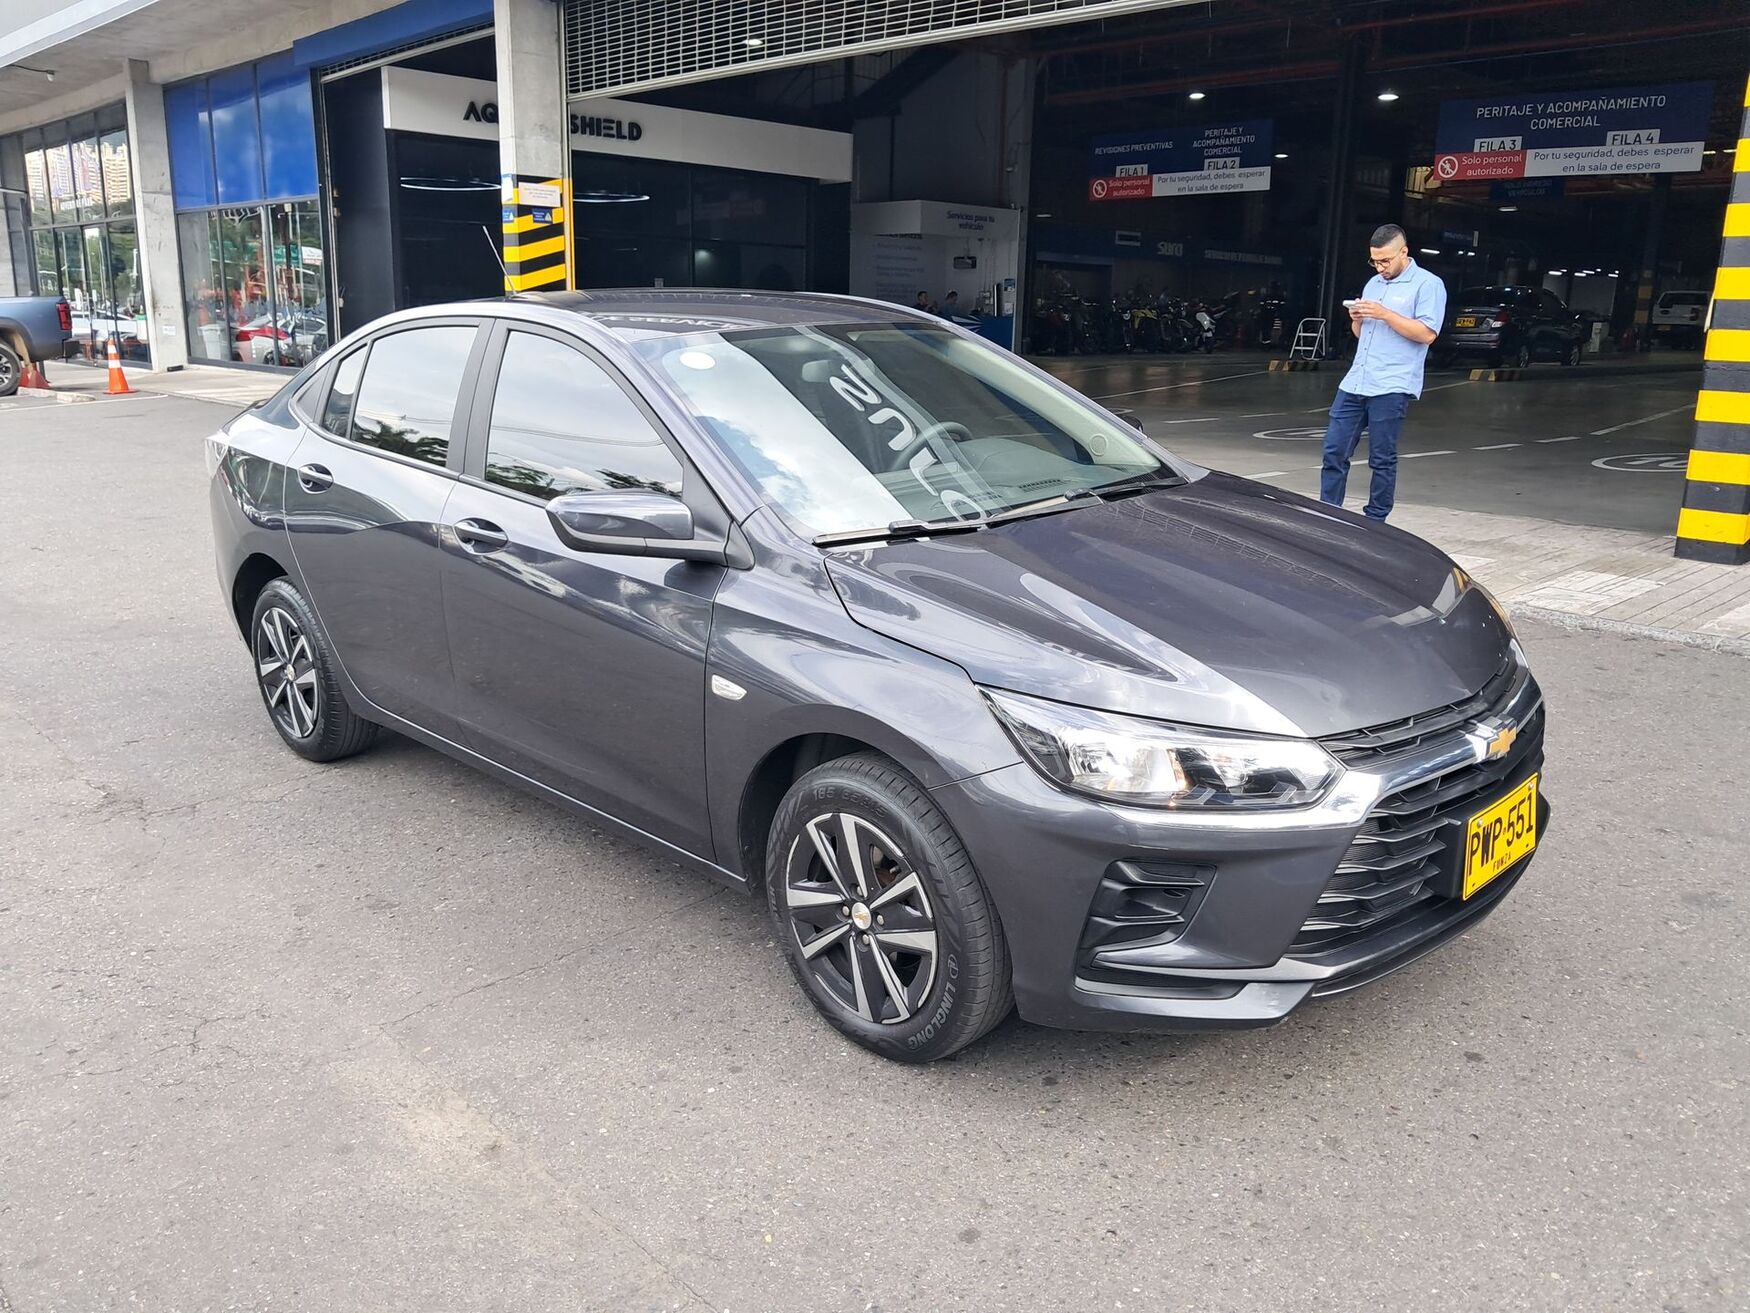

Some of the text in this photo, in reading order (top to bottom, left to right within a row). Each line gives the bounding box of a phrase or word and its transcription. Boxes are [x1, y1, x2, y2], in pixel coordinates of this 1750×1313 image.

[1476, 94, 1666, 118] PERITAJE Y ACOMPAÑAMIENTO
[570, 114, 642, 141] SHIELD
[1530, 115, 1600, 130] COMERCIAL
[1205, 126, 1244, 137] PERITAJE Y
[1192, 135, 1256, 148] ACOMPAÑAMIENTO
[1479, 139, 1517, 152] FILA 3
[1612, 132, 1654, 146] FILA 4
[1095, 141, 1174, 155] REVISIONES PREVENTIVAS
[1204, 146, 1242, 156] COMERCIAL
[1534, 146, 1695, 161] Por tu seguridad, debes esperar
[1207, 160, 1236, 170] FILA 2
[1462, 154, 1522, 166] Solo personal
[1119, 167, 1140, 176] FILA
[1466, 166, 1514, 176] autorizado
[1562, 161, 1661, 173] en la sala de espera
[1108, 178, 1150, 188] Solo personal
[1158, 175, 1170, 183] Por
[1177, 173, 1212, 183] seguridad,
[1213, 171, 1236, 180] debes
[1238, 170, 1266, 180] esperar
[1186, 184, 1193, 192] la
[1194, 183, 1208, 192] sala
[1209, 183, 1218, 191] de
[1219, 183, 1244, 192] espera
[946, 210, 973, 220] Servicios
[974, 215, 988, 223] para
[908, 982, 956, 1050] LINGLONG
